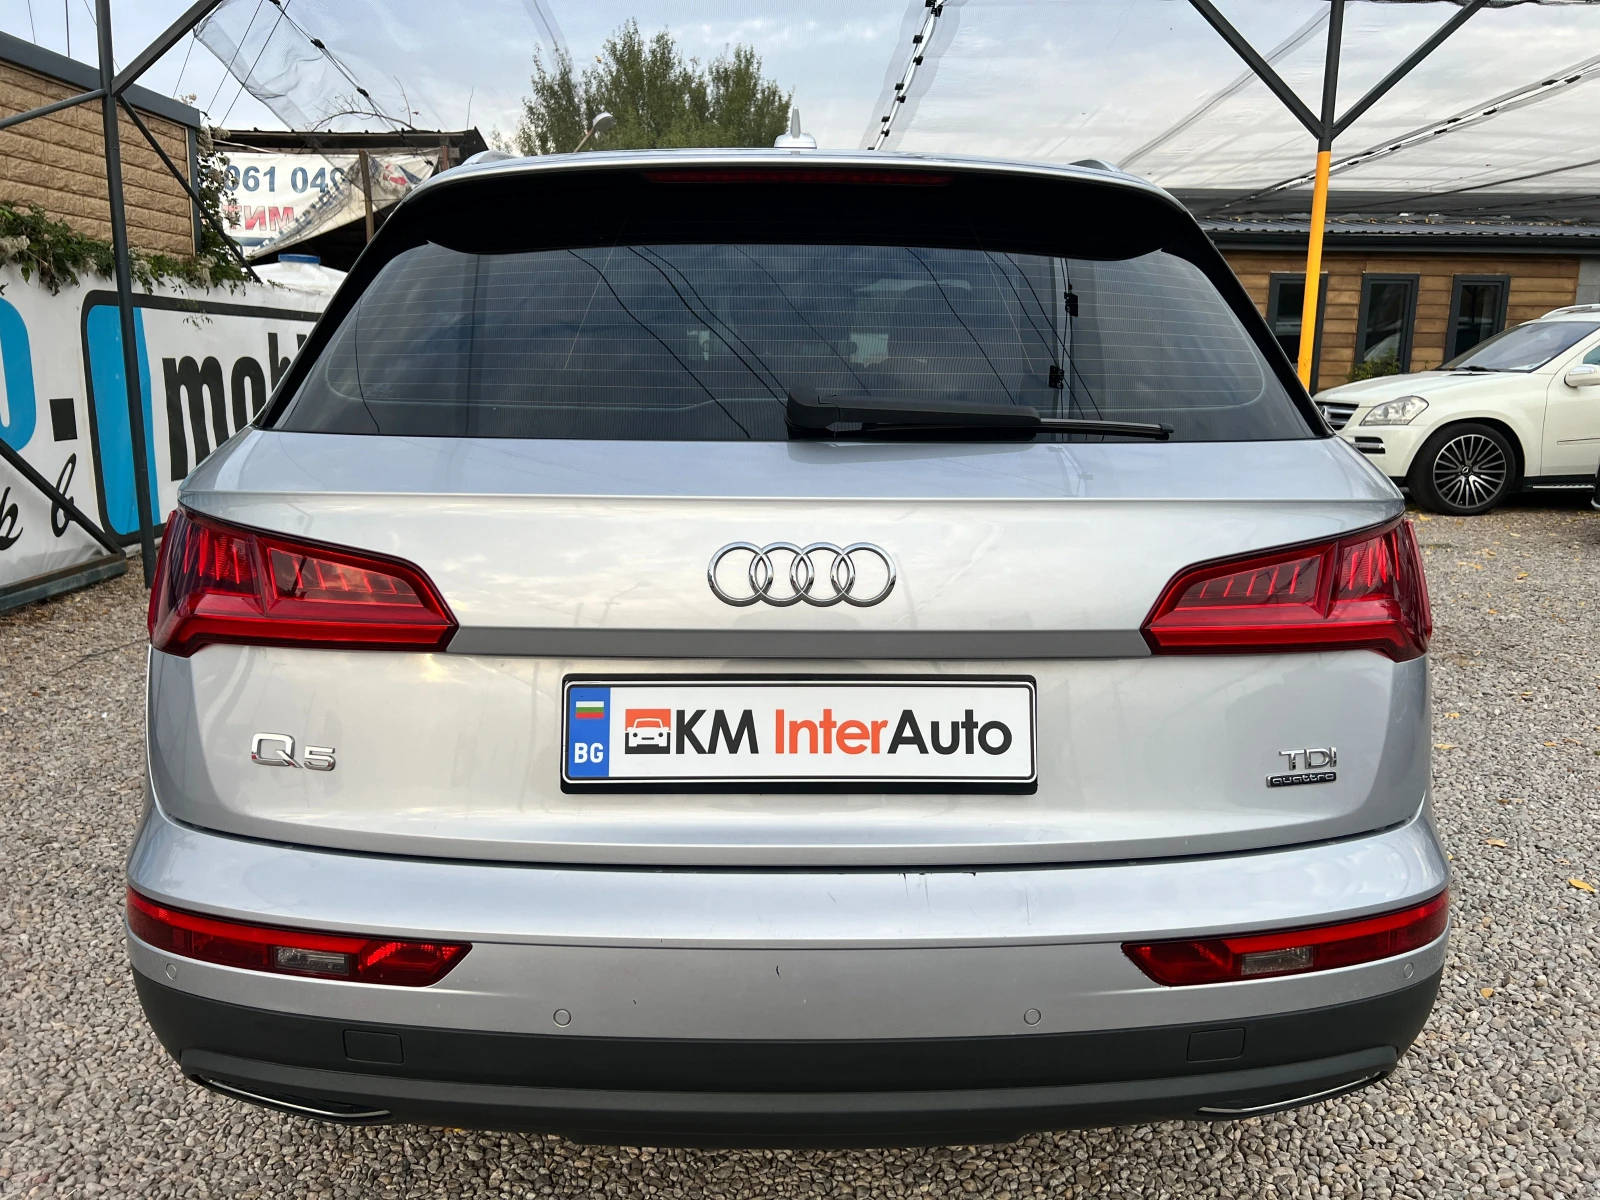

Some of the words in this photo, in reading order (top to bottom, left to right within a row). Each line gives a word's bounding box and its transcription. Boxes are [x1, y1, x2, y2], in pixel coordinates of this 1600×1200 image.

[675, 708, 759, 755] KM
[775, 708, 1013, 756] InterAuto
[251, 731, 337, 772] Q5
[574, 741, 604, 764] BG
[1278, 746, 1338, 771] TDI
[1271, 773, 1336, 786] quattro
